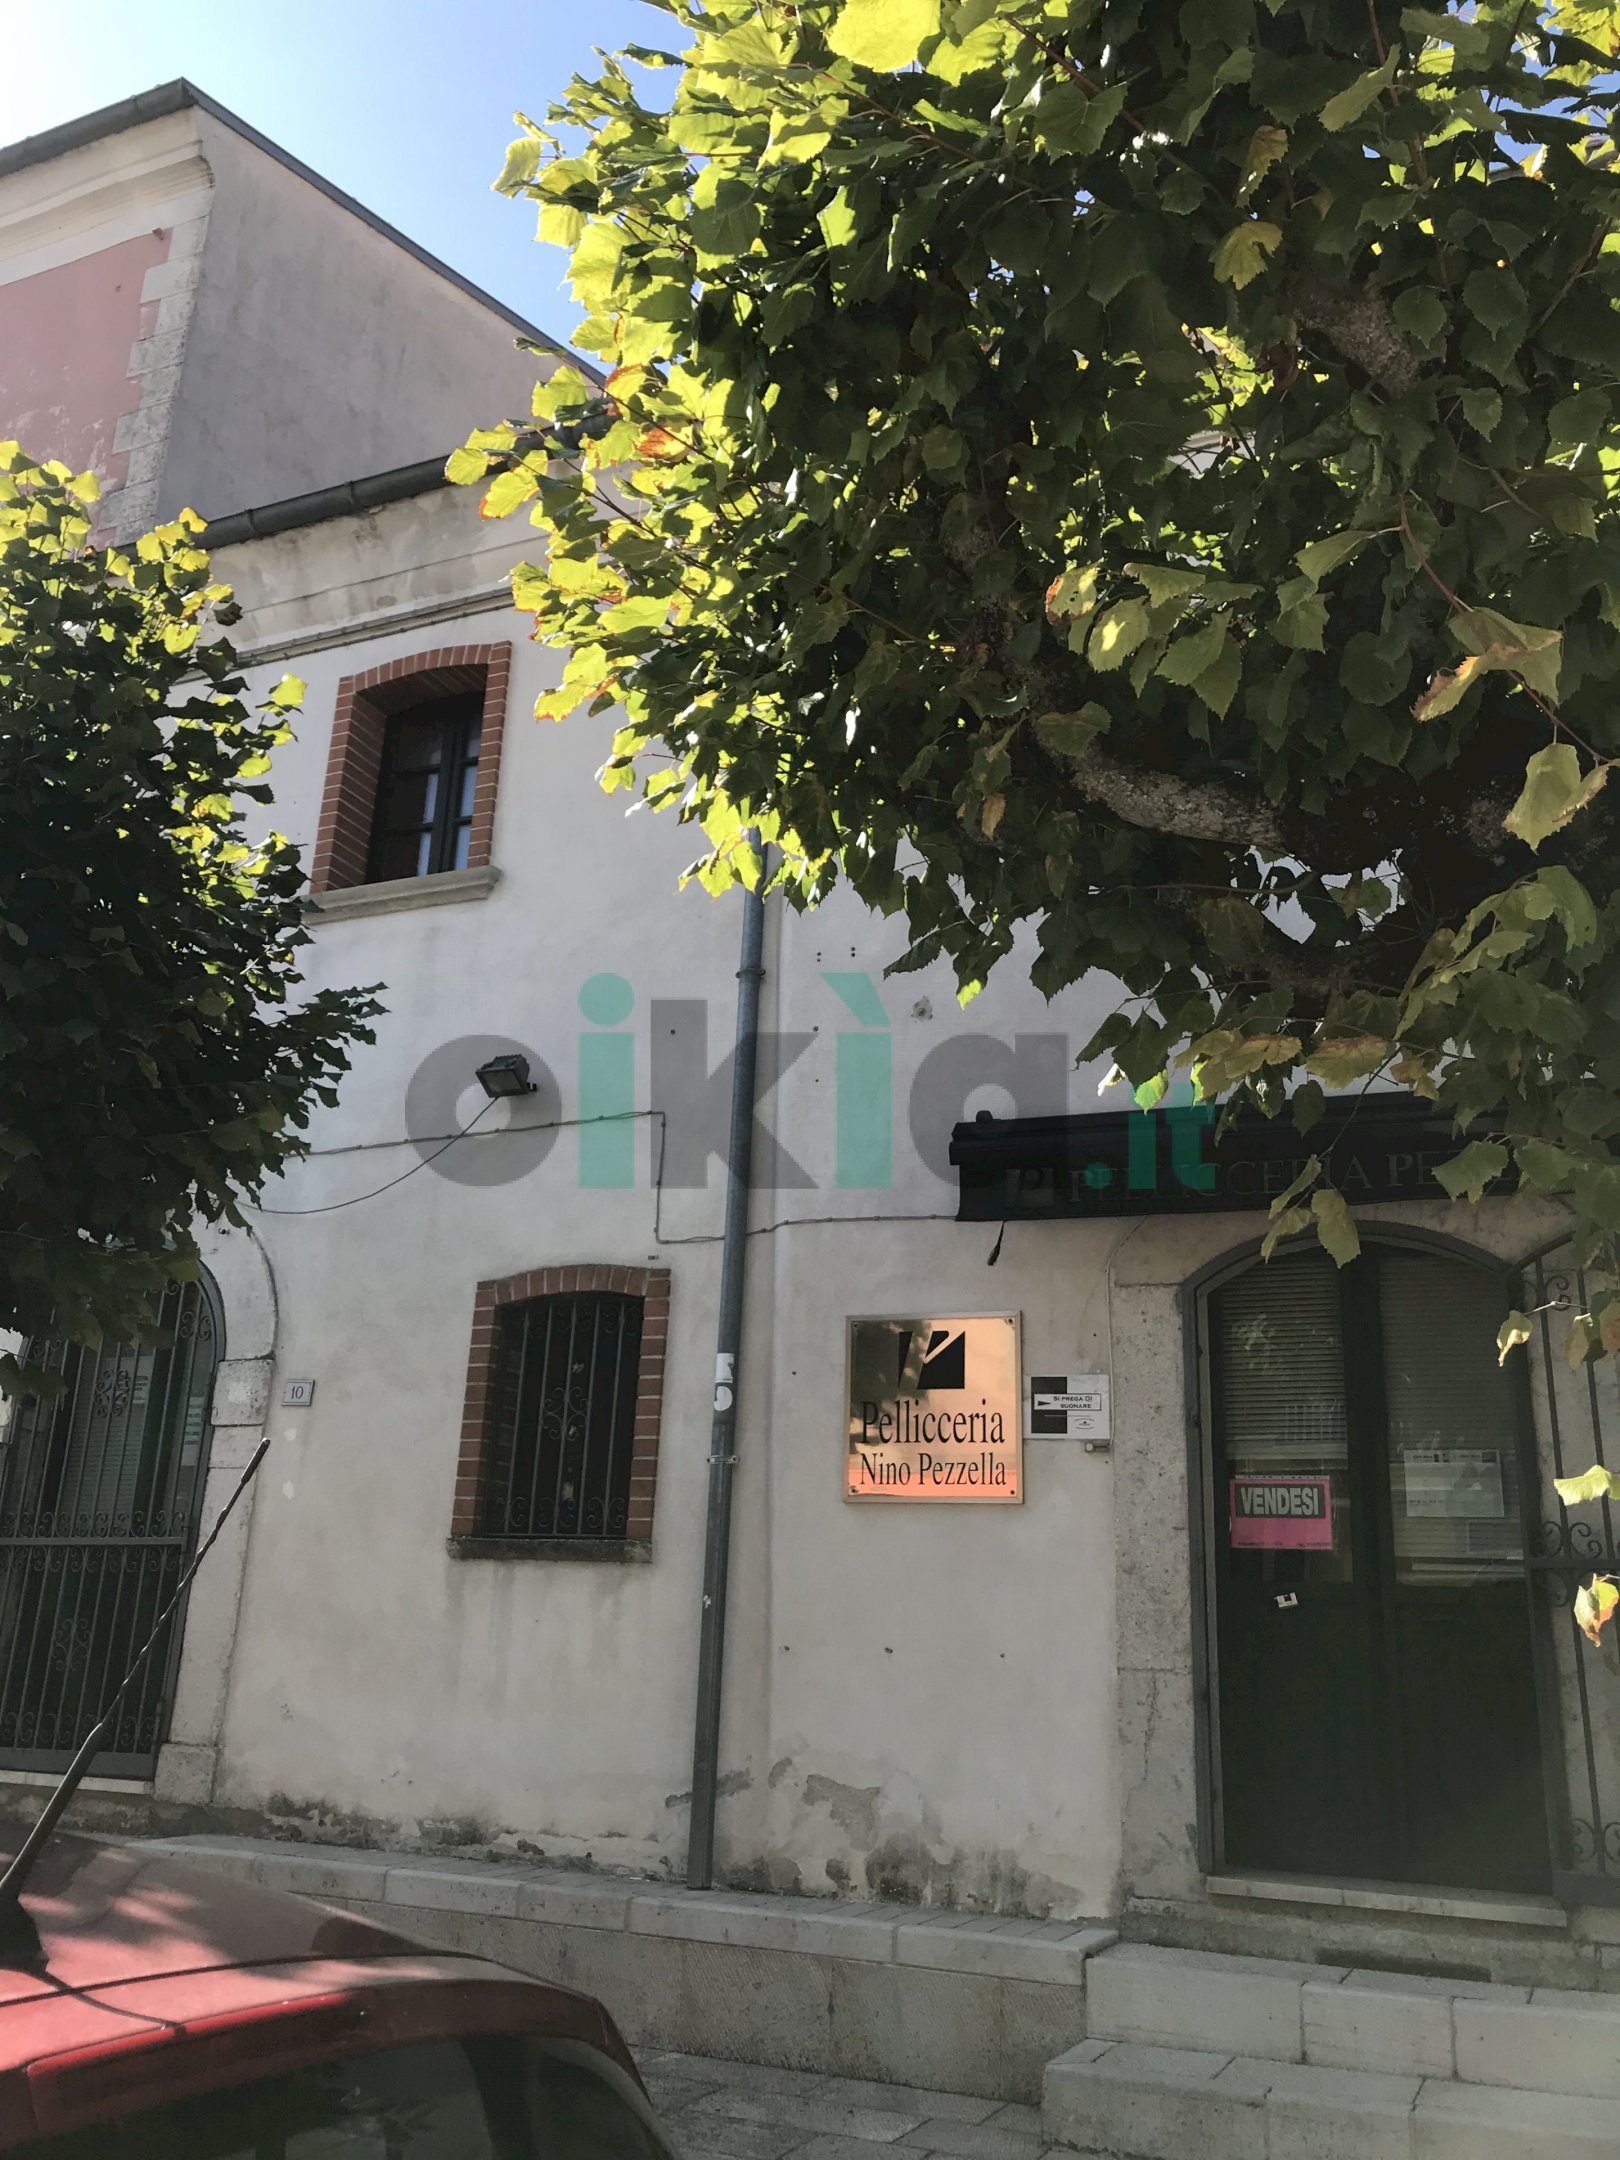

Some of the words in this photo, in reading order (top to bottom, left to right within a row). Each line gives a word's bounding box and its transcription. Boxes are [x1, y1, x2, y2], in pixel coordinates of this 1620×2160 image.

[291, 1385, 304, 1399] 10
[861, 1398, 1005, 1444] Pellicceria
[860, 1452, 911, 1485] Nino
[918, 1451, 1007, 1485] Pezzella
[1240, 1487, 1319, 1516] VENDESI
